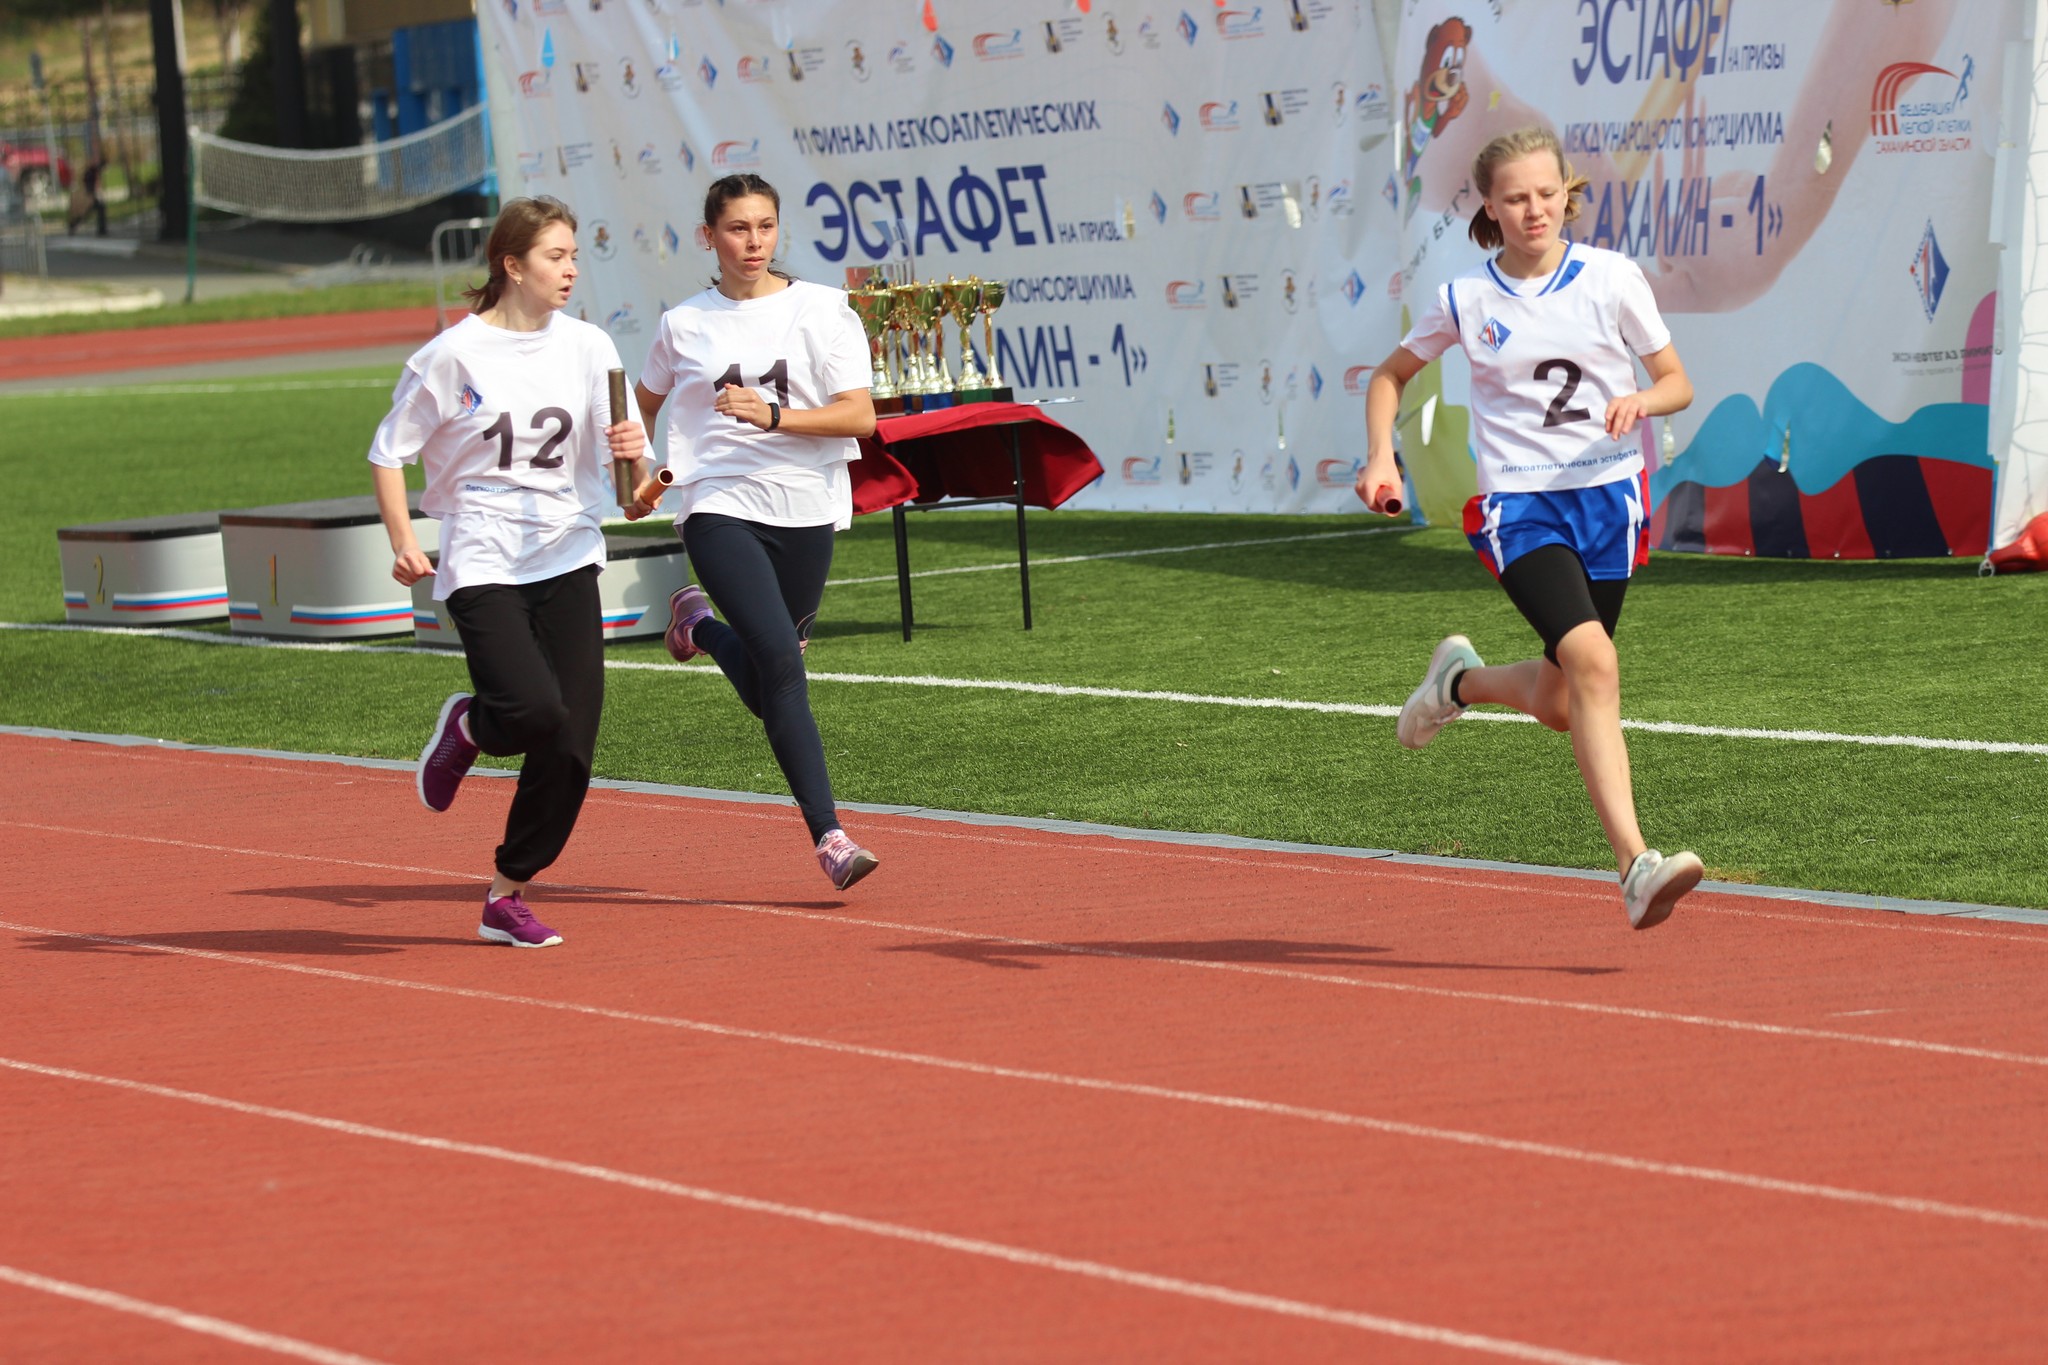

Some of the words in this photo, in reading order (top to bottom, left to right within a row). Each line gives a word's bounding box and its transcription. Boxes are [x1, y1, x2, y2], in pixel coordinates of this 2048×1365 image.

[1741, 43, 1785, 71] ПРИЗЫ
[811, 123, 883, 156] ФИНАЛ
[887, 100, 1101, 151] ЛЕГКОАТЛЕТИЧЕСКИХ
[805, 164, 1055, 262] ЭСТАФЕТ
[1057, 222, 1079, 243] НА
[1008, 273, 1136, 303] КОНСОРЦИУМА
[1533, 358, 1591, 428] 2
[483, 406, 573, 471] 12
[1501, 458, 1598, 473] Легкоатлетическая
[1600, 448, 1638, 465] эстафета
[93, 554, 106, 606] 2
[268, 554, 279, 607] 1
